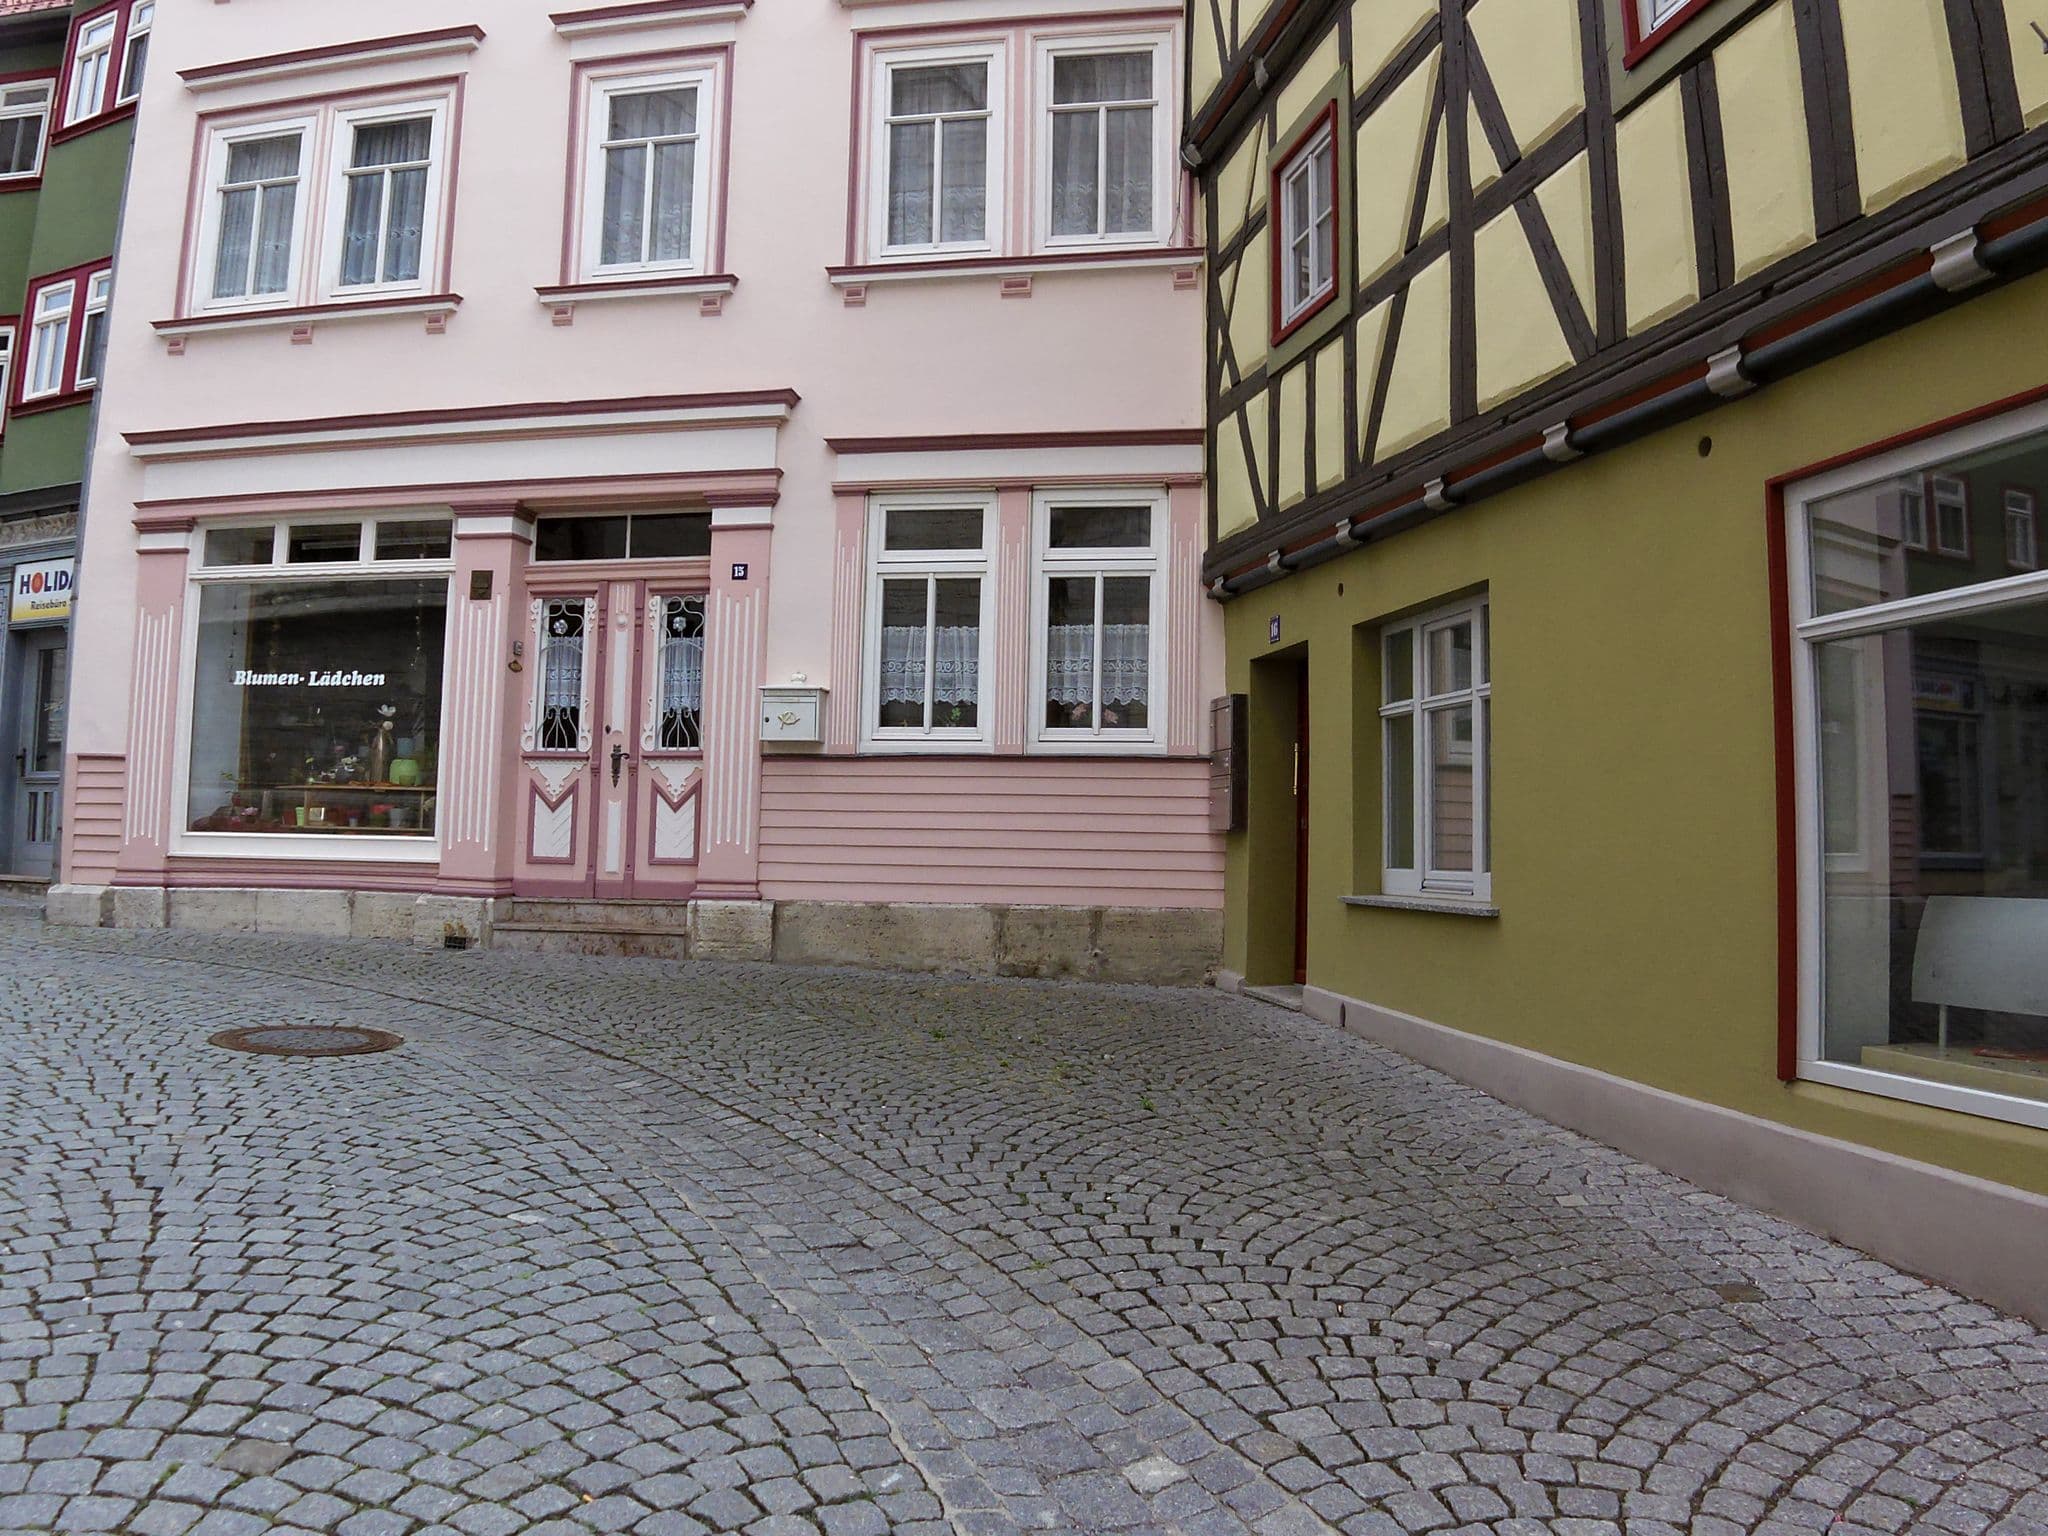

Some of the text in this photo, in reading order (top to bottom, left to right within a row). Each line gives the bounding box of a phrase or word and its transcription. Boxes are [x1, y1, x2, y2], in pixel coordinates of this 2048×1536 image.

[734, 566, 745, 577] 15
[233, 670, 385, 687] Blumen- Lädchen
